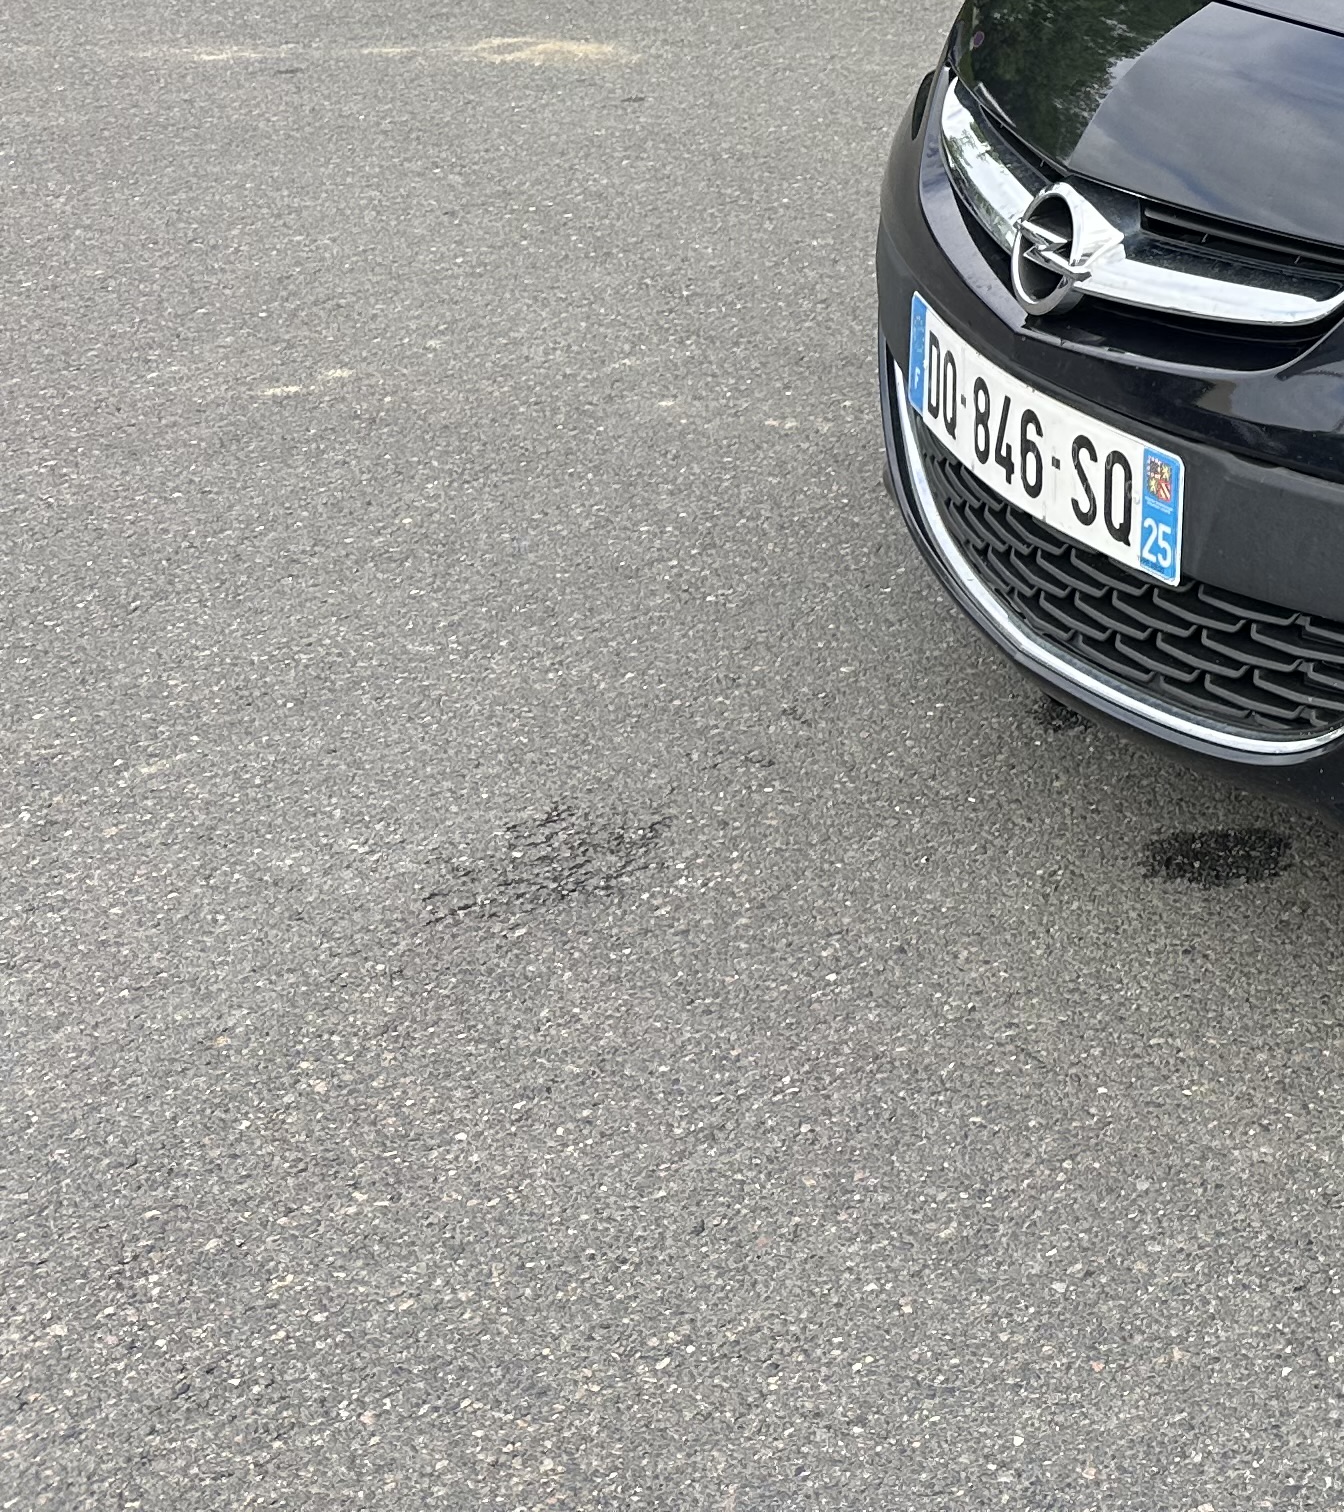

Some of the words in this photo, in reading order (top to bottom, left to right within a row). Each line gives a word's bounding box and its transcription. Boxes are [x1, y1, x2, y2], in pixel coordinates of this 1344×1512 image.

[914, 365, 921, 390] F
[927, 330, 1133, 546] DQ-846-SQ
[1142, 517, 1172, 569] 25
